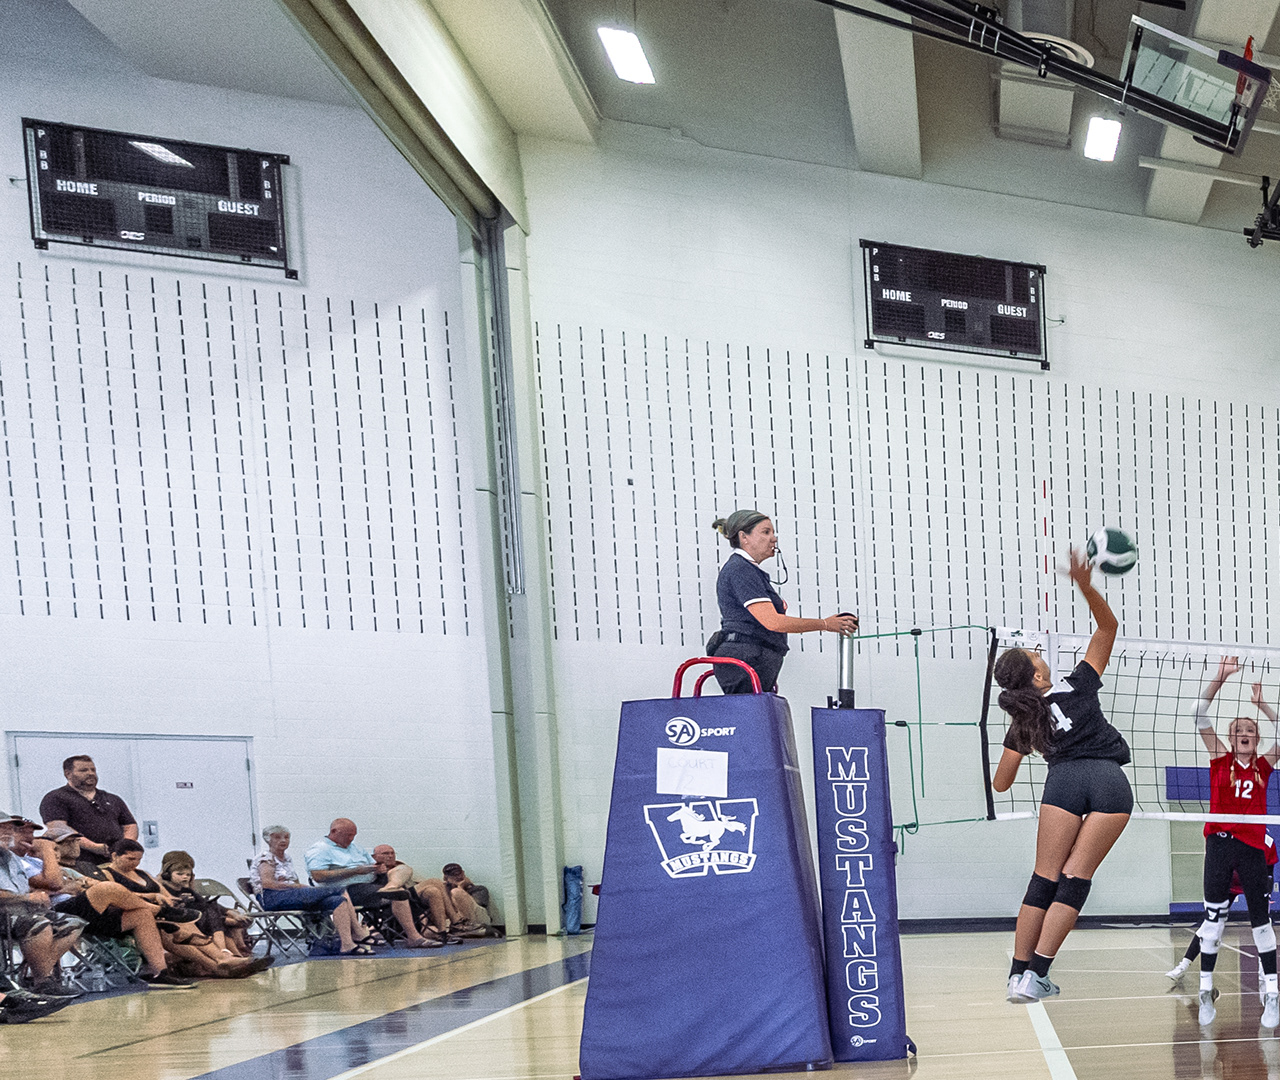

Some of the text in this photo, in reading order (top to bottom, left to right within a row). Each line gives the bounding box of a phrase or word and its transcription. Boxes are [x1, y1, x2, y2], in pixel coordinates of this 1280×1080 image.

[56, 179, 99, 197] HOME
[137, 191, 177, 206] PERIOD
[217, 199, 260, 216] GUEST
[882, 288, 912, 302] HOME
[940, 298, 969, 310] PERIOD
[997, 304, 1028, 318] GUEST
[700, 727, 736, 738] SPORT
[667, 756, 718, 770] COURT
[1235, 779, 1254, 799] 12
[670, 853, 749, 872] MUSTANGS
[825, 746, 882, 1028] MUSTANGS
